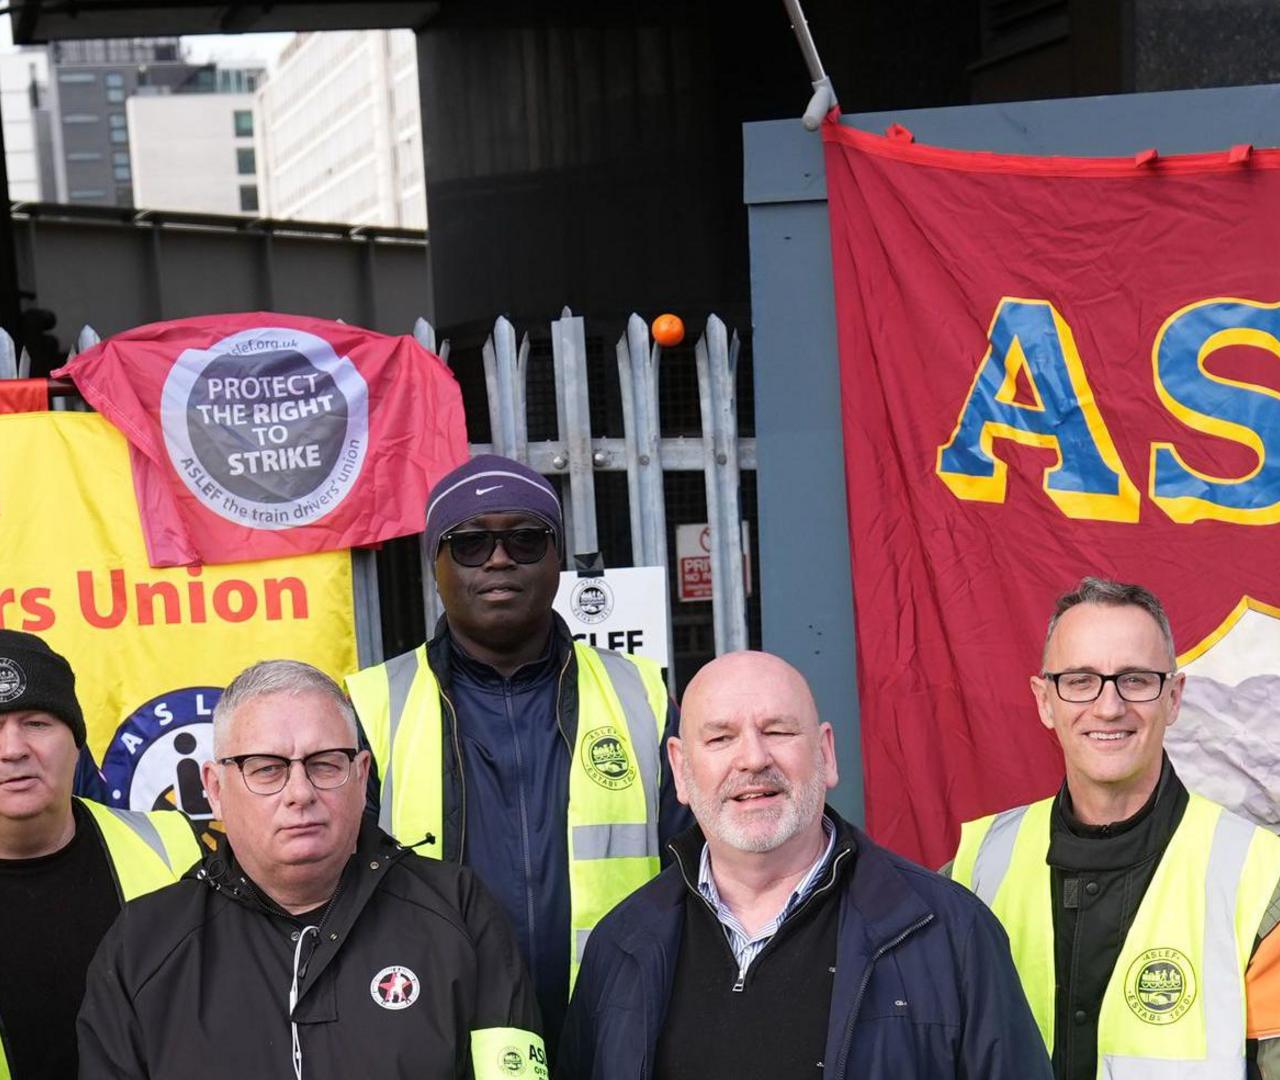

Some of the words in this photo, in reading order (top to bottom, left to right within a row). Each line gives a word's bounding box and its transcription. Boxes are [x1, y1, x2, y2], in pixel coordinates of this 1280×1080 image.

[231, 338, 299, 356] slef.org.uk
[207, 373, 320, 400] PROTECT
[196, 403, 248, 426] THE
[253, 395, 334, 425] RIGHT
[252, 425, 289, 446] TO
[227, 444, 322, 477] STRIKE
[180, 456, 223, 502] ASLEF
[222, 497, 248, 519] the
[251, 507, 290, 524] train
[338, 438, 361, 484] union
[76, 565, 310, 630] Union
[120, 693, 212, 756] ASL
[1145, 949, 1178, 960] ASLEF
